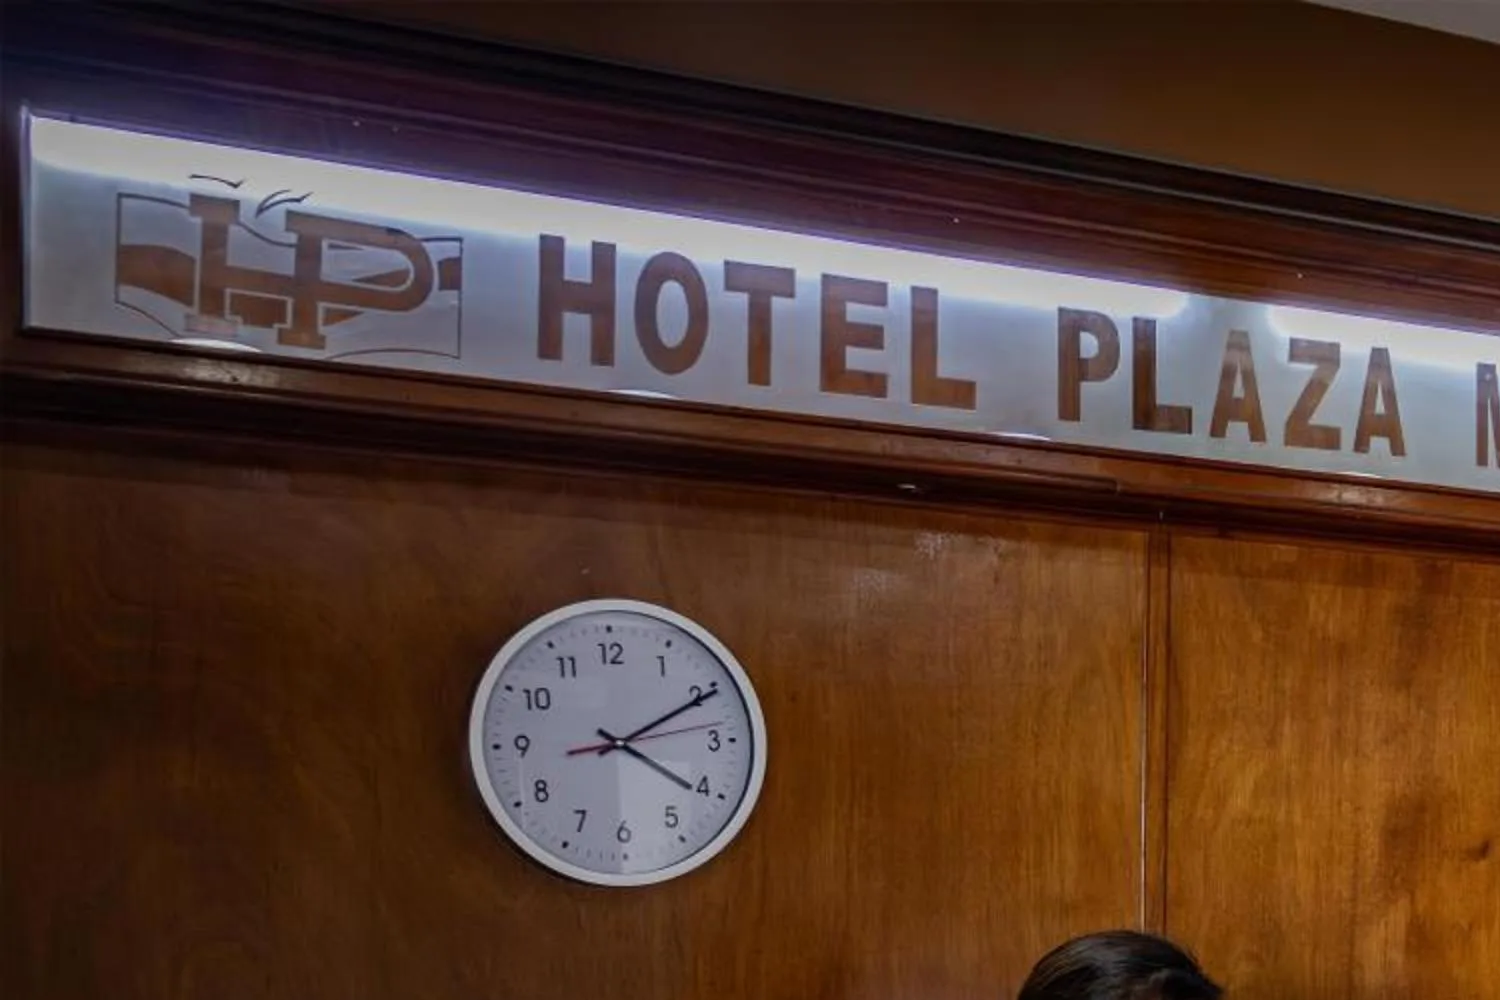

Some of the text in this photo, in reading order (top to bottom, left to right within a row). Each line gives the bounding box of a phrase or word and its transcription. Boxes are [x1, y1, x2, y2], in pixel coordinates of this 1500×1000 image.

[537, 233, 977, 411] HOTEL
[1057, 306, 1407, 457] PLAZA
[597, 642, 625, 666] 12
[555, 655, 578, 679] 11
[656, 655, 667, 678] 1
[522, 686, 552, 711] 10
[689, 684, 703, 707] 2
[514, 734, 531, 758] 9
[707, 729, 721, 753] 3
[533, 779, 550, 803] 8
[695, 775, 711, 797] 4
[573, 809, 588, 833] 7
[664, 804, 680, 829] 5
[616, 820, 632, 844] 6
